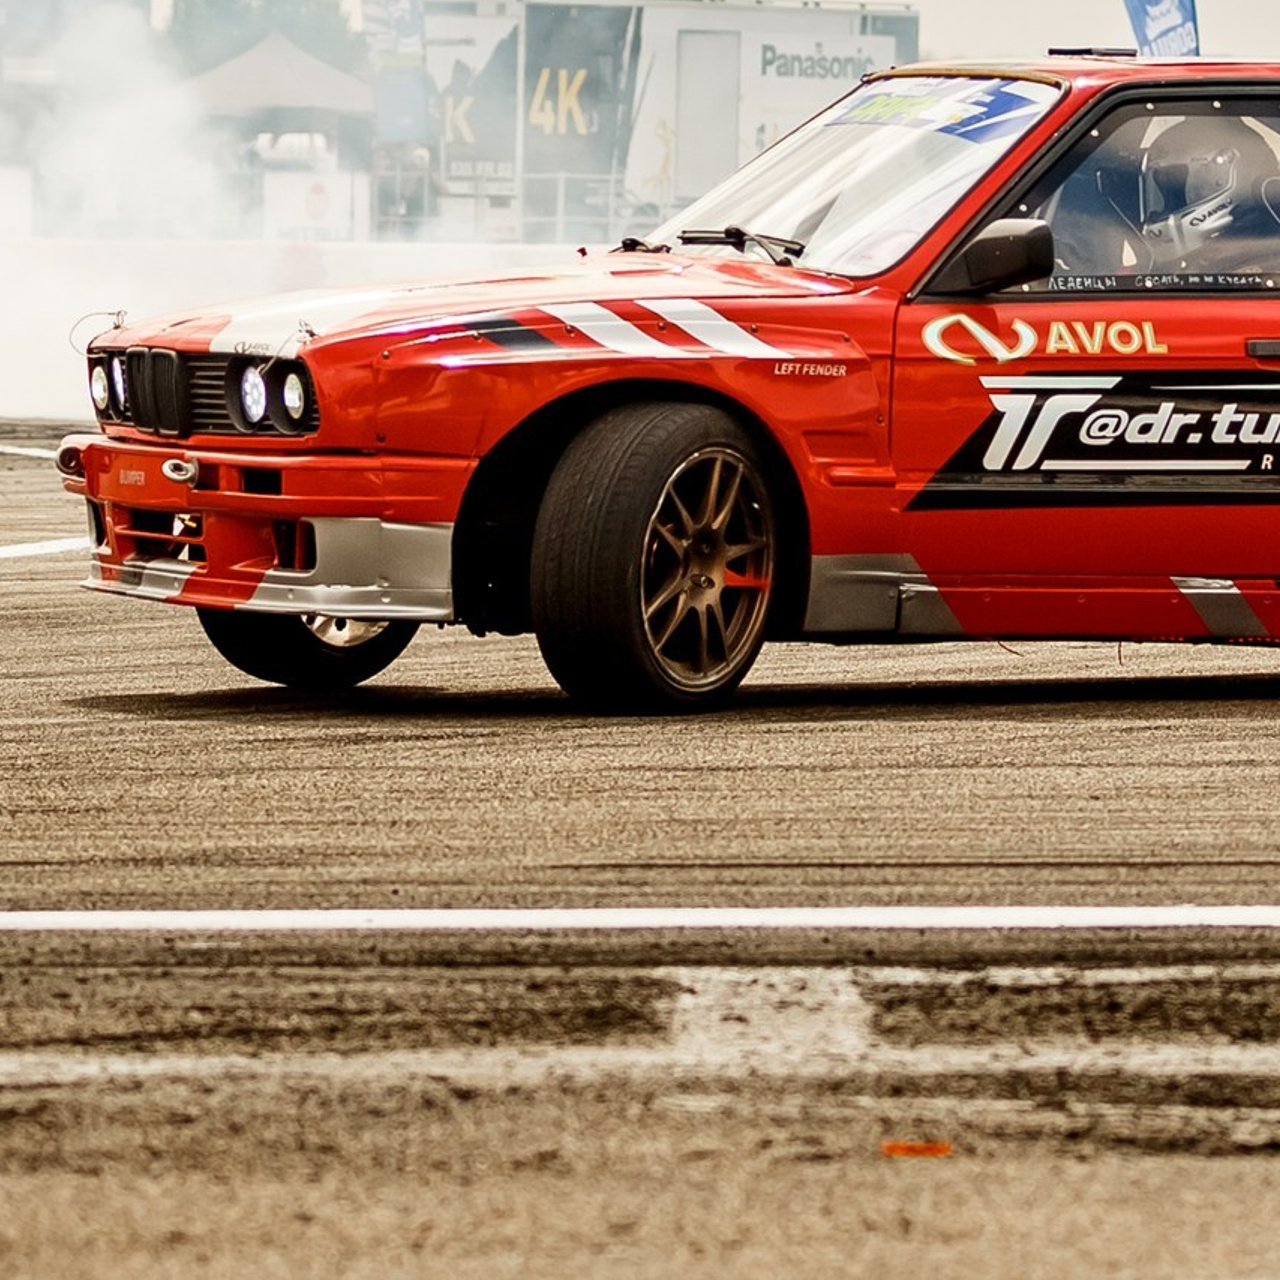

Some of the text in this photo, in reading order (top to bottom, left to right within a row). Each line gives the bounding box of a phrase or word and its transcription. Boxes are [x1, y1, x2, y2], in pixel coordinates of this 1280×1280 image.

[529, 67, 588, 136] 4K
[1045, 321, 1168, 354] AVOL
[774, 363, 847, 377] LEFT FENDER
